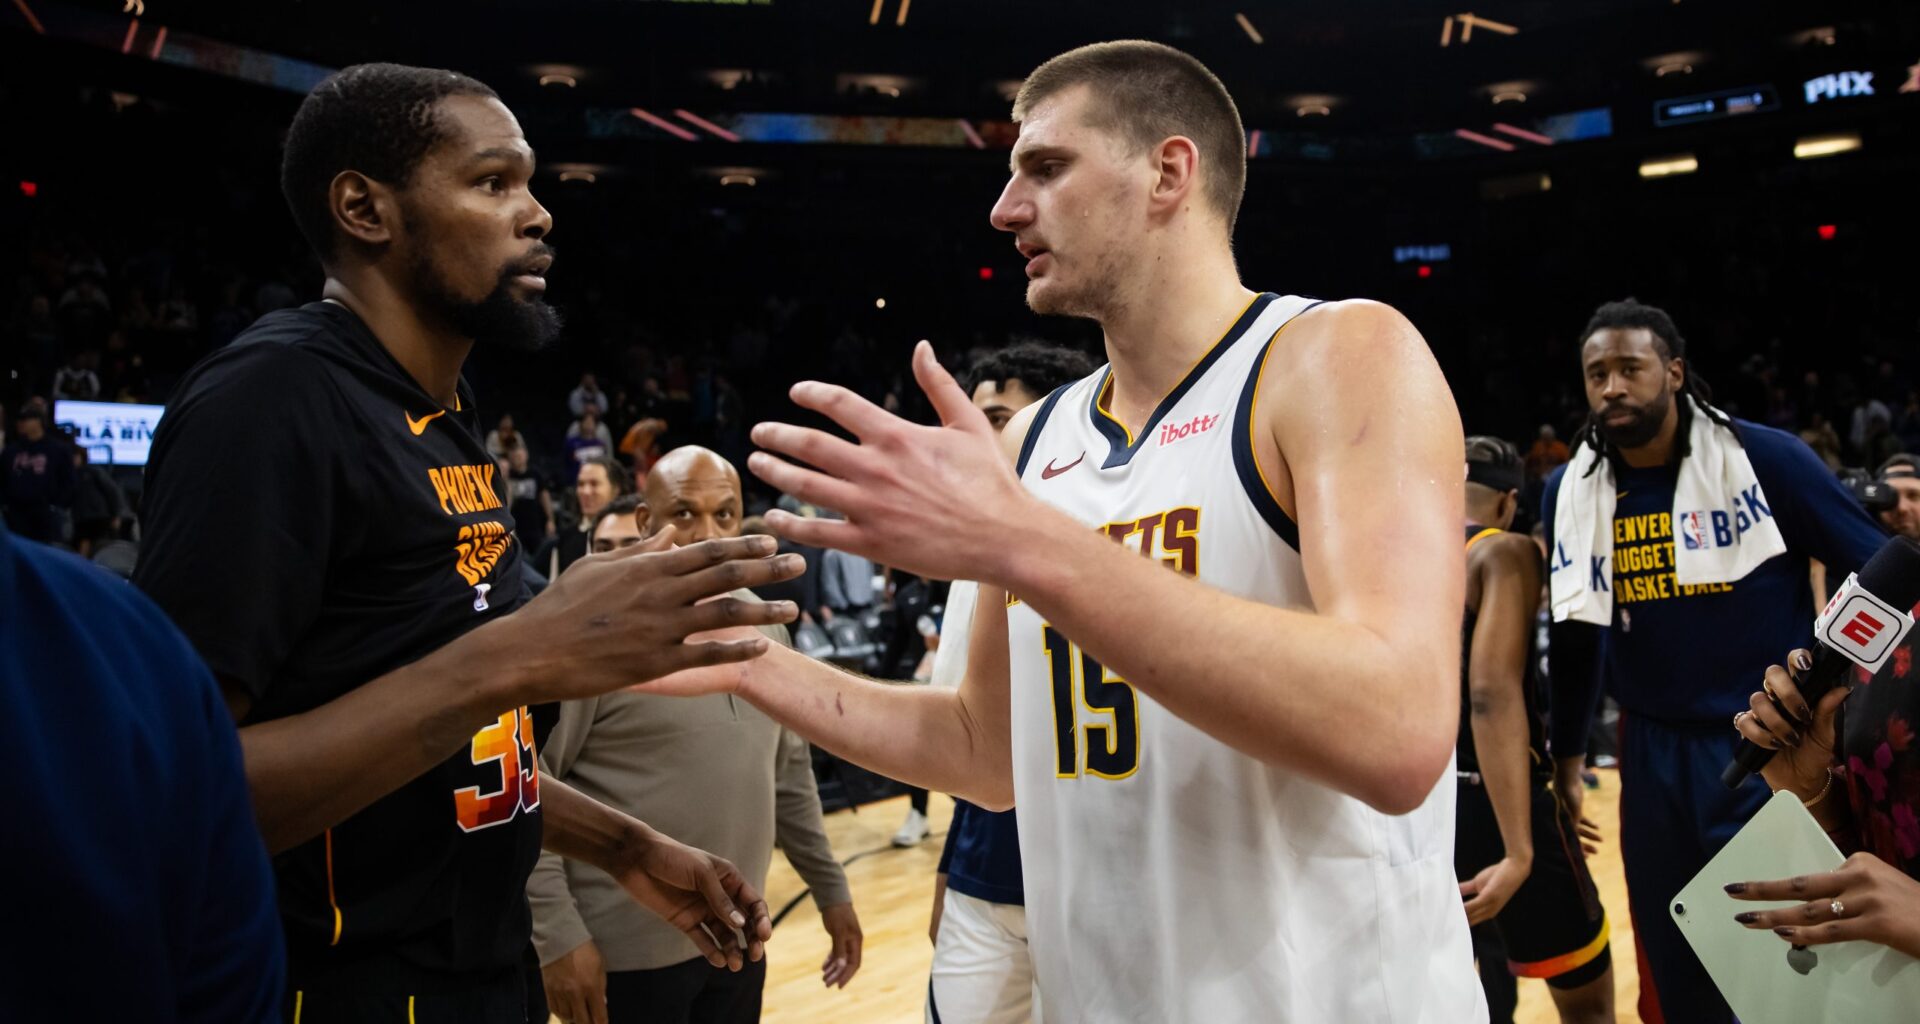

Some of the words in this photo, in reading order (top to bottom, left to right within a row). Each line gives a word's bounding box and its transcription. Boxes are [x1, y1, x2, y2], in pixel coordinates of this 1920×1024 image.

[1803, 71, 1875, 104] PHX
[64, 423, 113, 440] ILA
[1614, 511, 1672, 544] ENVER
[1613, 541, 1676, 574] UGGET
[1839, 609, 1886, 648] E
[1041, 623, 1141, 781] 15
